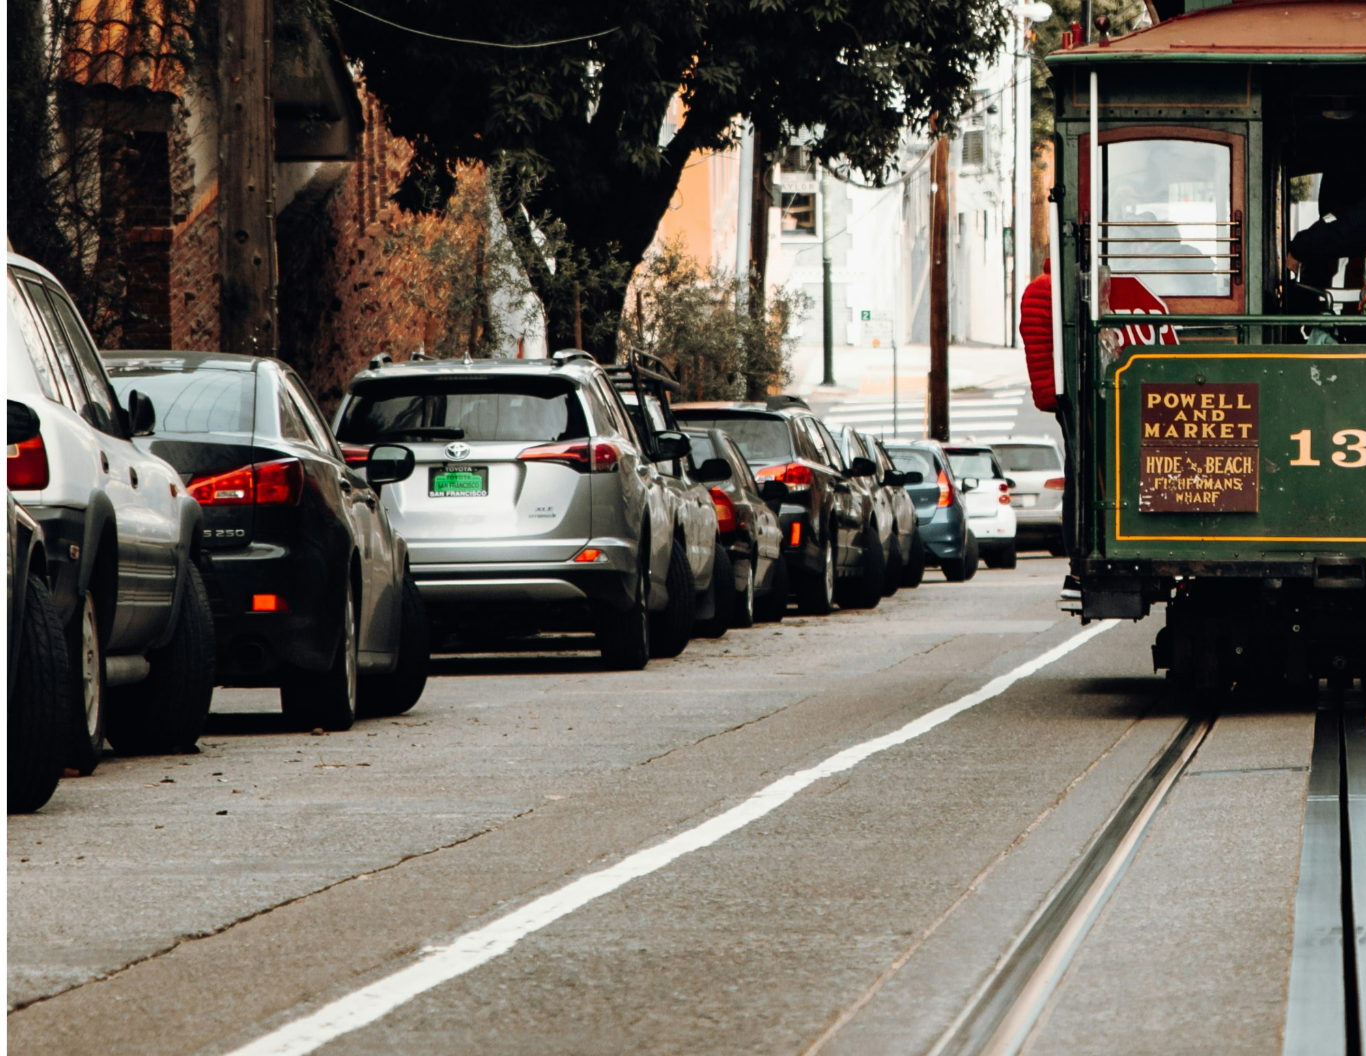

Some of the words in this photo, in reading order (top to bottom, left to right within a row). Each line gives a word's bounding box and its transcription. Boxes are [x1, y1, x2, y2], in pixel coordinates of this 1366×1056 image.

[1147, 392, 1252, 409] POWELL
[1174, 409, 1225, 422] AND
[1144, 422, 1253, 439] MARKET
[1146, 456, 1182, 474] HYDE
[1186, 457, 1203, 474] AND
[1205, 456, 1252, 474] BEACH
[1175, 491, 1220, 503] WHARF
[203, 529, 212, 537] S
[215, 529, 245, 537] 250
